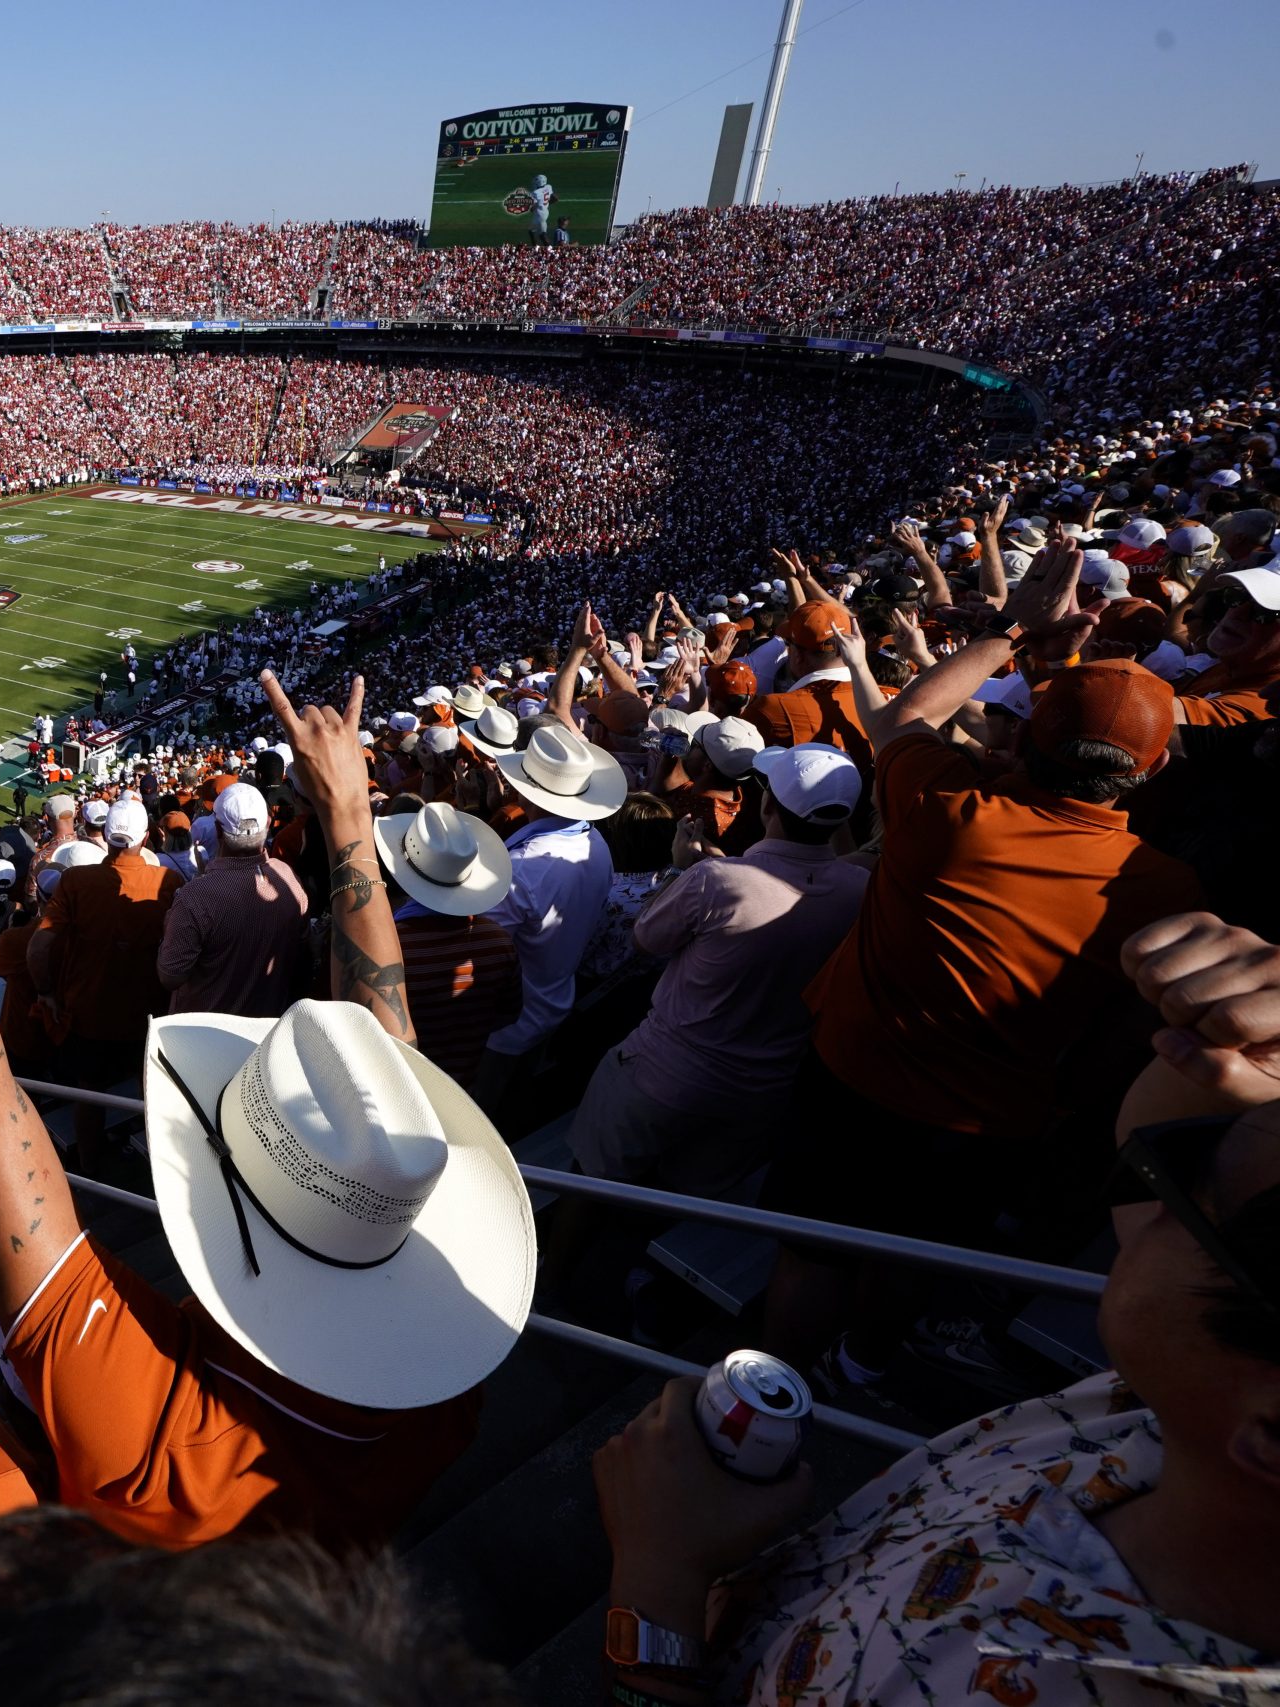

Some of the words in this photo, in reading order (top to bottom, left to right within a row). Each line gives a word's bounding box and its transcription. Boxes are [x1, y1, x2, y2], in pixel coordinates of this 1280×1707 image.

[498, 108, 536, 118] WELCOME
[537, 107, 547, 115] TO
[549, 105, 565, 114] THE
[462, 119, 537, 139] COTTON
[539, 113, 598, 134] BOWL
[475, 147, 482, 155] 7
[573, 141, 578, 149] 3
[380, 319, 390, 328] 33
[523, 322, 534, 331] 33
[90, 489, 431, 539] OKLAHOMA
[439, 511, 464, 520] SOONERS
[1131, 564, 1162, 574] TEXA
[113, 627, 143, 639] 50
[32, 656, 67, 669] 40
[152, 698, 188, 716] SOONERS
[95, 720, 145, 743] OKLAHOMA
